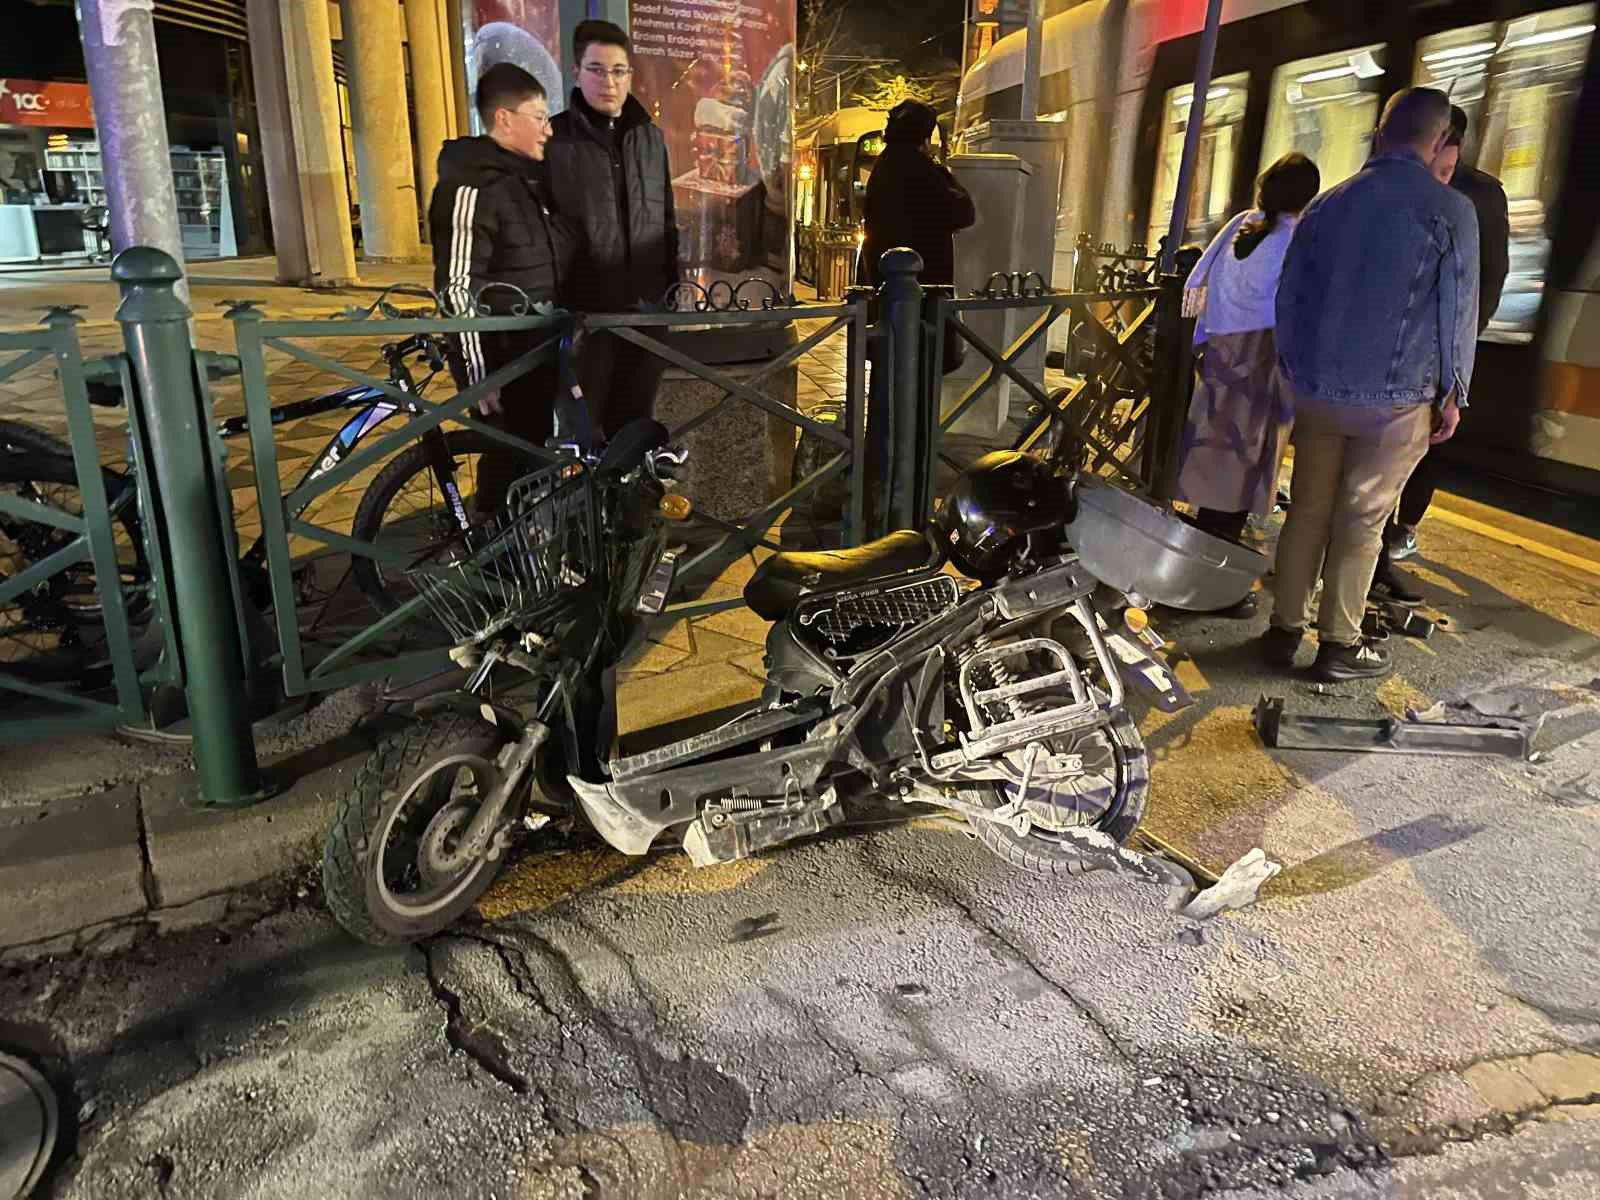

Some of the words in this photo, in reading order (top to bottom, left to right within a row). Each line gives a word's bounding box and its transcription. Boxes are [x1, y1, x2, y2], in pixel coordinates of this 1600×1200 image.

[632, 18, 675, 30] Mehmet
[632, 31, 666, 42] Erdem
[667, 34, 709, 48] Erdoğan
[633, 45, 666, 57] Emrah
